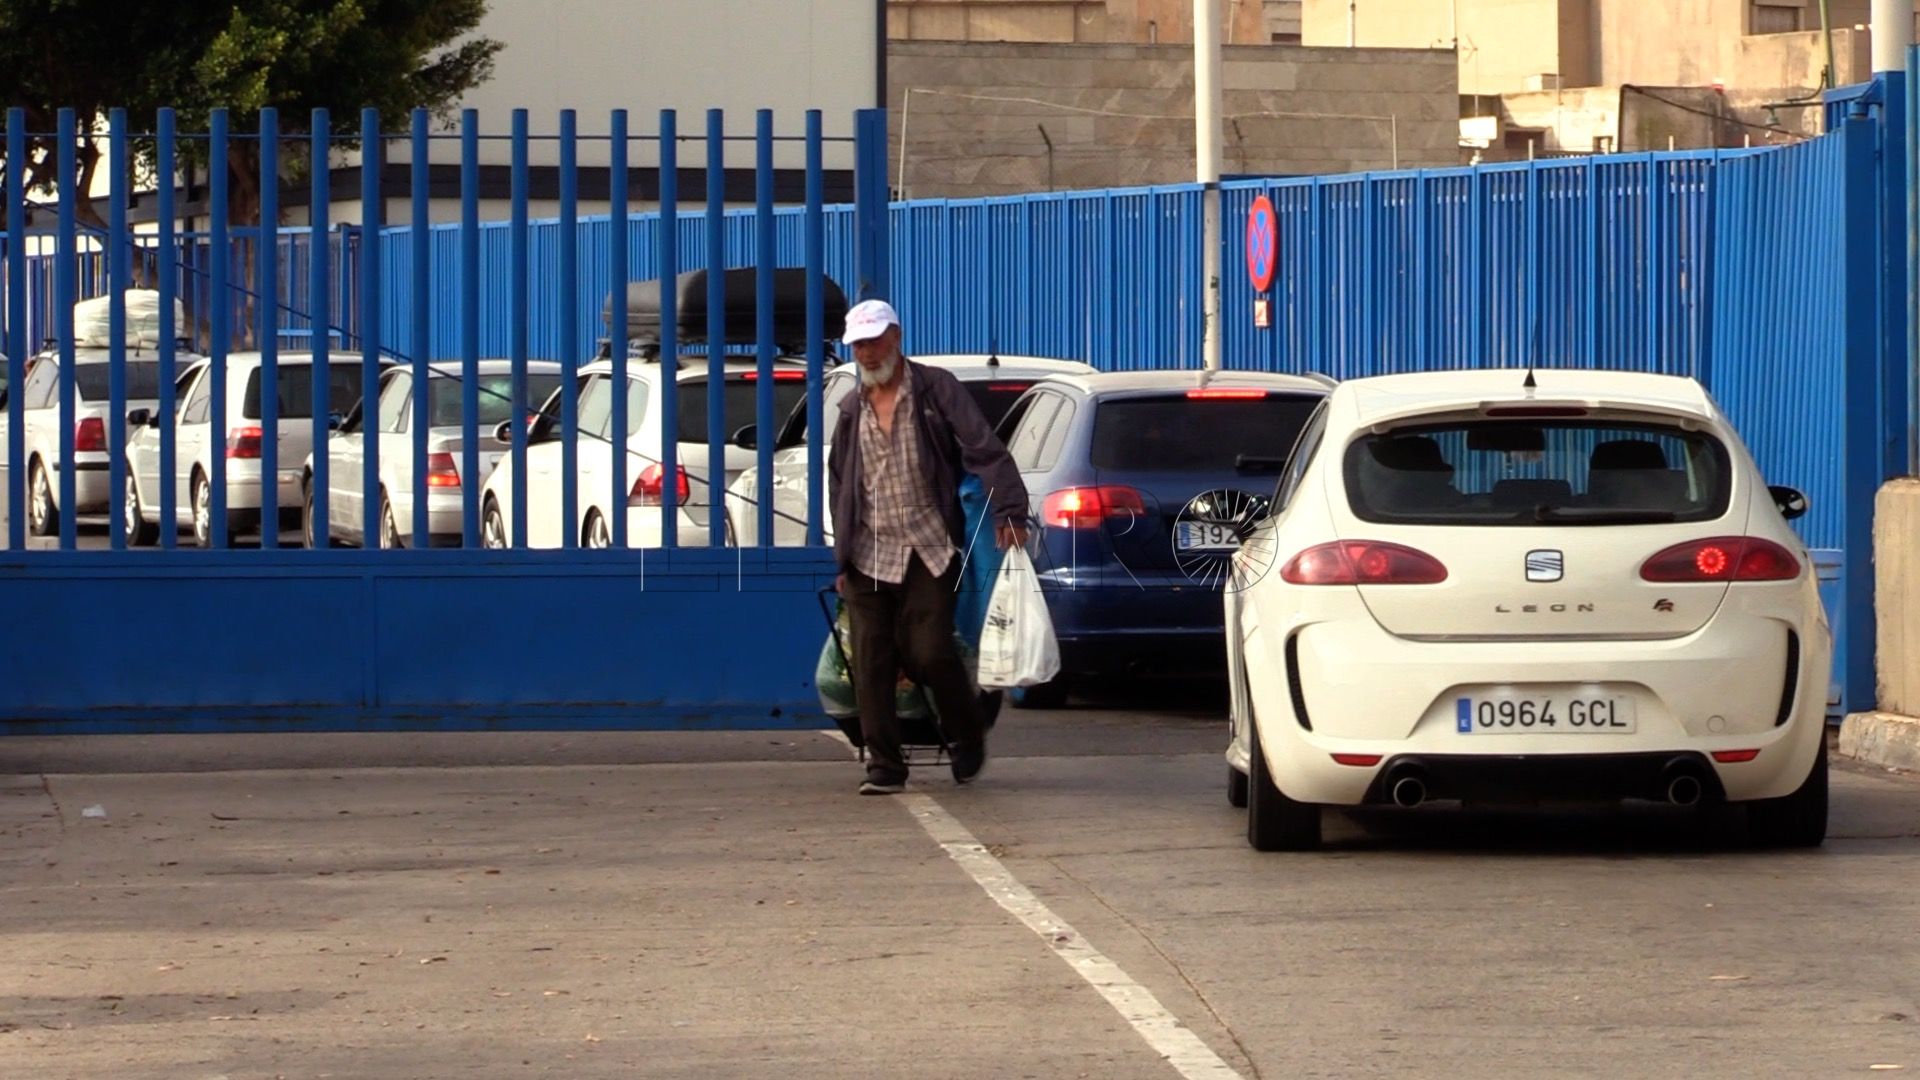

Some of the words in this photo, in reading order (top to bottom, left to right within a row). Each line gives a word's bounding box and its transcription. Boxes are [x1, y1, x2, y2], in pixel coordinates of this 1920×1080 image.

[1495, 603, 1594, 613] LEON
[1478, 700, 1556, 727] 0964
[1569, 700, 1627, 727] GCL
